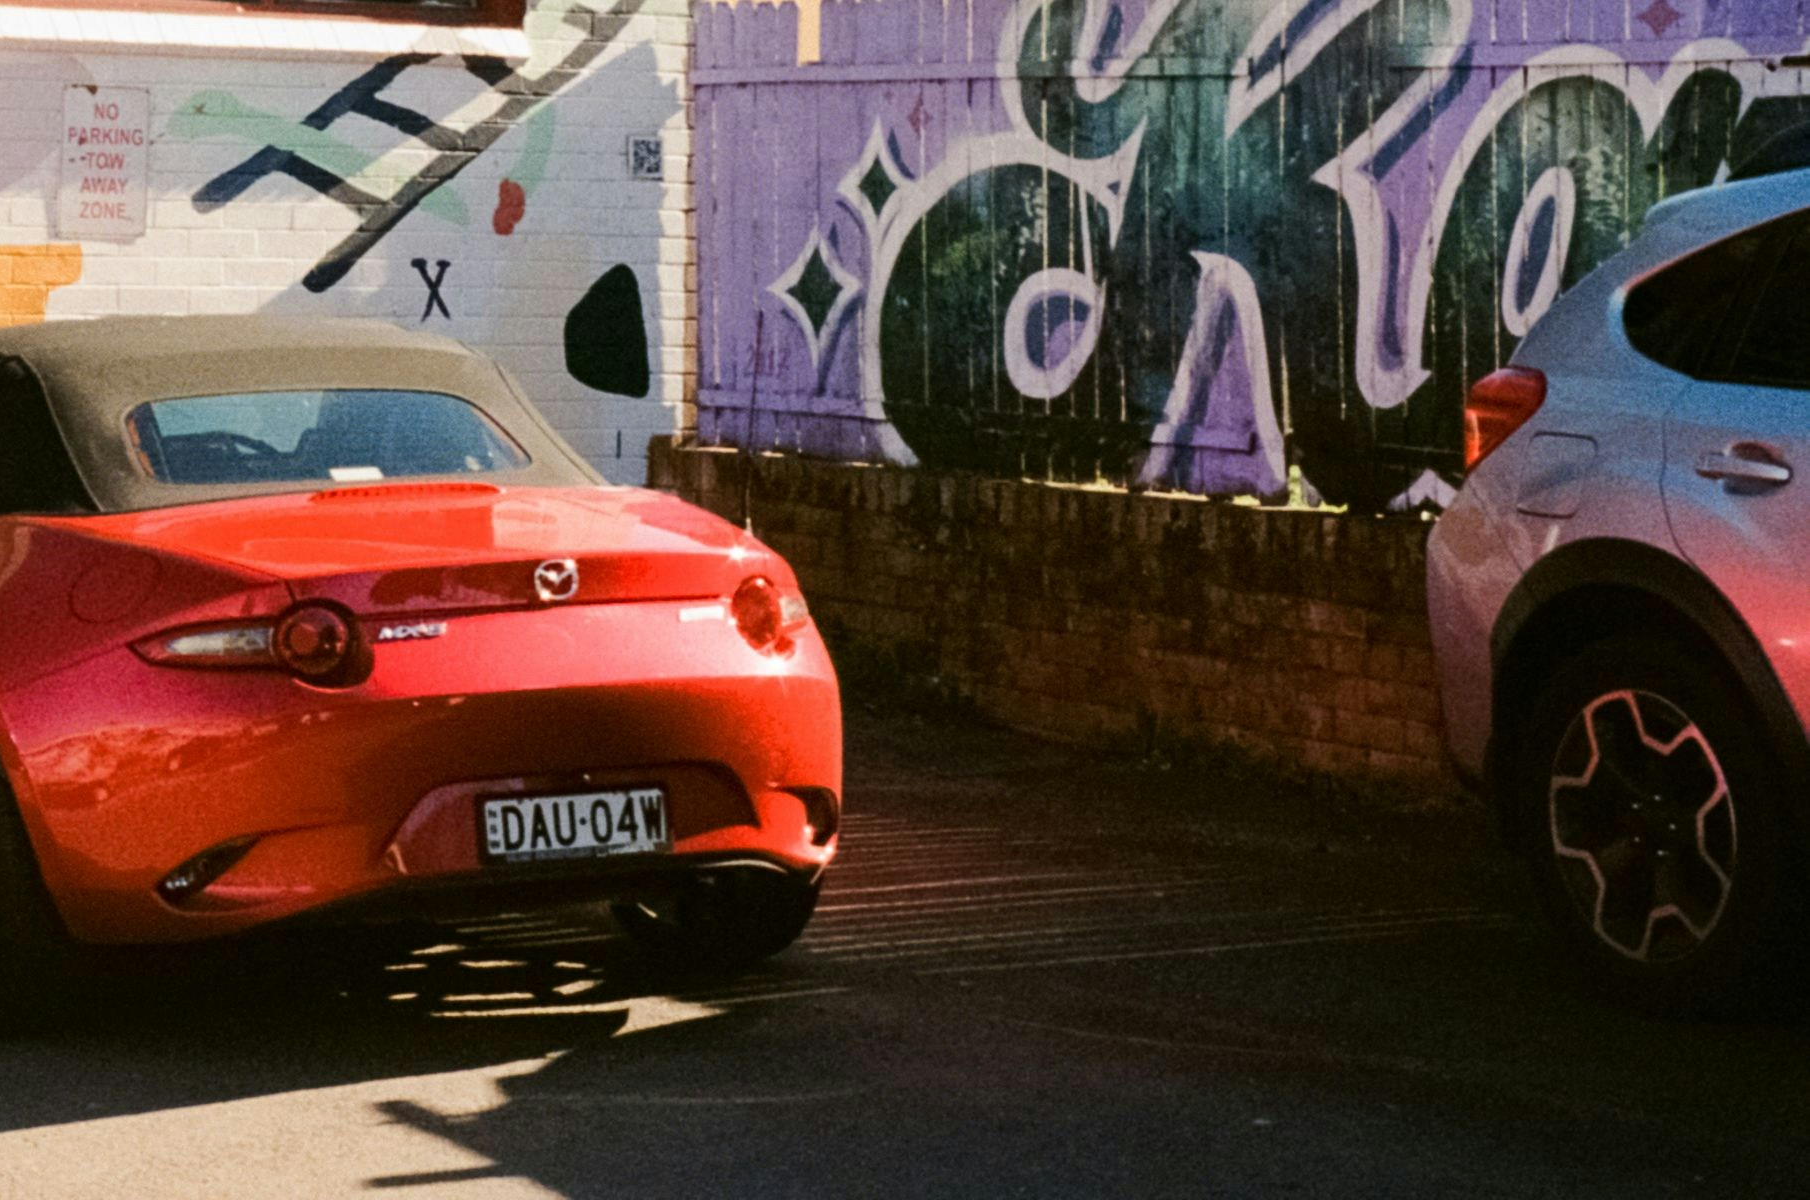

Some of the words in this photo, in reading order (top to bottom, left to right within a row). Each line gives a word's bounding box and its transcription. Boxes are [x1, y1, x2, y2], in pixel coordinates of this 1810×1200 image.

[93, 103, 119, 121] NO
[67, 127, 144, 146] PARKING
[85, 152, 126, 170] TOW
[79, 177, 128, 195] AWAY
[78, 201, 128, 219] ZONE
